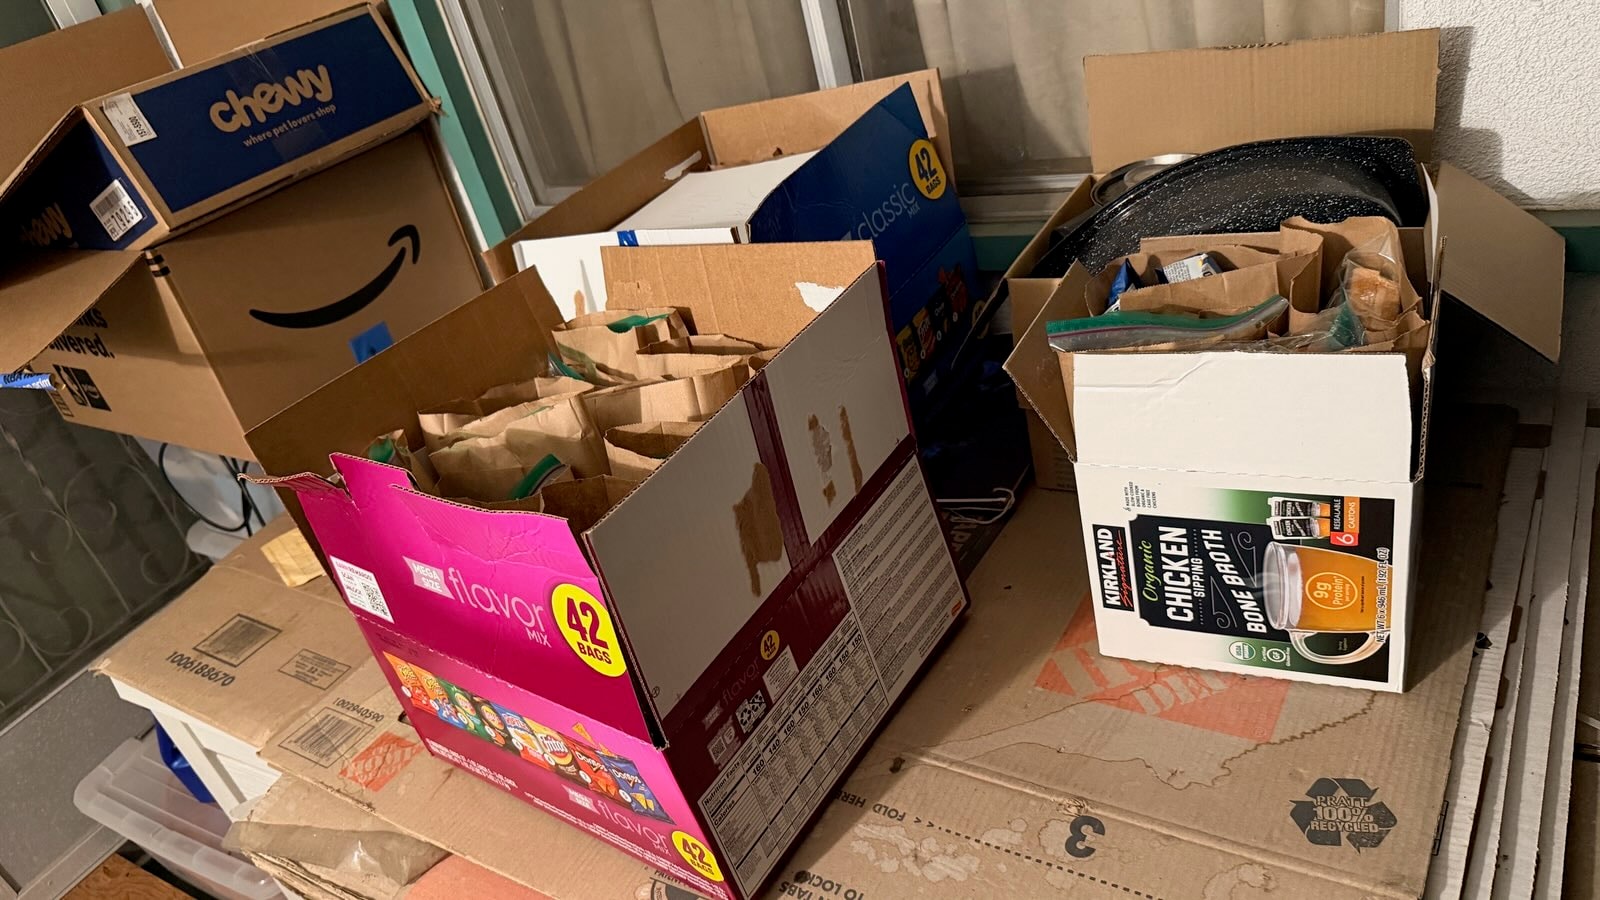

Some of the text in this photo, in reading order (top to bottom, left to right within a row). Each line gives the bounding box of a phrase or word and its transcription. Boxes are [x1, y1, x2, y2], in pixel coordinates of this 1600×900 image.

[209, 64, 333, 132] chewy
[243, 104, 337, 147] where pet lovers shop
[915, 147, 938, 182] 42
[925, 176, 942, 194] BAGS
[858, 182, 916, 241] classic
[1333, 498, 1341, 530] RESEALABLE
[1348, 501, 1356, 529] CARTONS
[1336, 533, 1354, 545] 6
[1377, 546, 1389, 560] OZ)
[1377, 560, 1387, 568] FL
[411, 563, 441, 581] MEGA
[1097, 528, 1122, 606] KIRKLAND
[1114, 529, 1134, 608] Signature
[1138, 540, 1163, 602] Organic
[1158, 526, 1194, 623] CHICKEN
[1191, 557, 1206, 598] SIPPING
[1376, 569, 1387, 584] (192
[421, 577, 443, 593] SIZE
[1200, 529, 1268, 634] BONE BROTH
[1313, 581, 1332, 599] 9g
[1377, 585, 1386, 595] mL
[448, 567, 545, 633] flavor
[1377, 596, 1385, 608] 946
[566, 597, 610, 650] 42
[1376, 619, 1385, 630] WT
[525, 627, 552, 649] MIX
[763, 634, 776, 654] 42
[1376, 631, 1385, 643] NET
[576, 641, 613, 665] BAGS
[165, 650, 236, 687] 1006188670
[332, 697, 385, 722] 1002940590
[713, 634, 862, 826] Calories 160 140 160 150 160 160 150 150
[703, 777, 727, 806] Nutrition
[726, 761, 741, 779] Facts
[872, 803, 906, 822] FOLD
[1312, 806, 1375, 823] 100%
[1315, 795, 1368, 808] PRATT
[597, 800, 668, 849] flavor
[1065, 815, 1105, 858] 3
[1309, 821, 1380, 833] RECYCLED
[681, 837, 713, 868] 42
